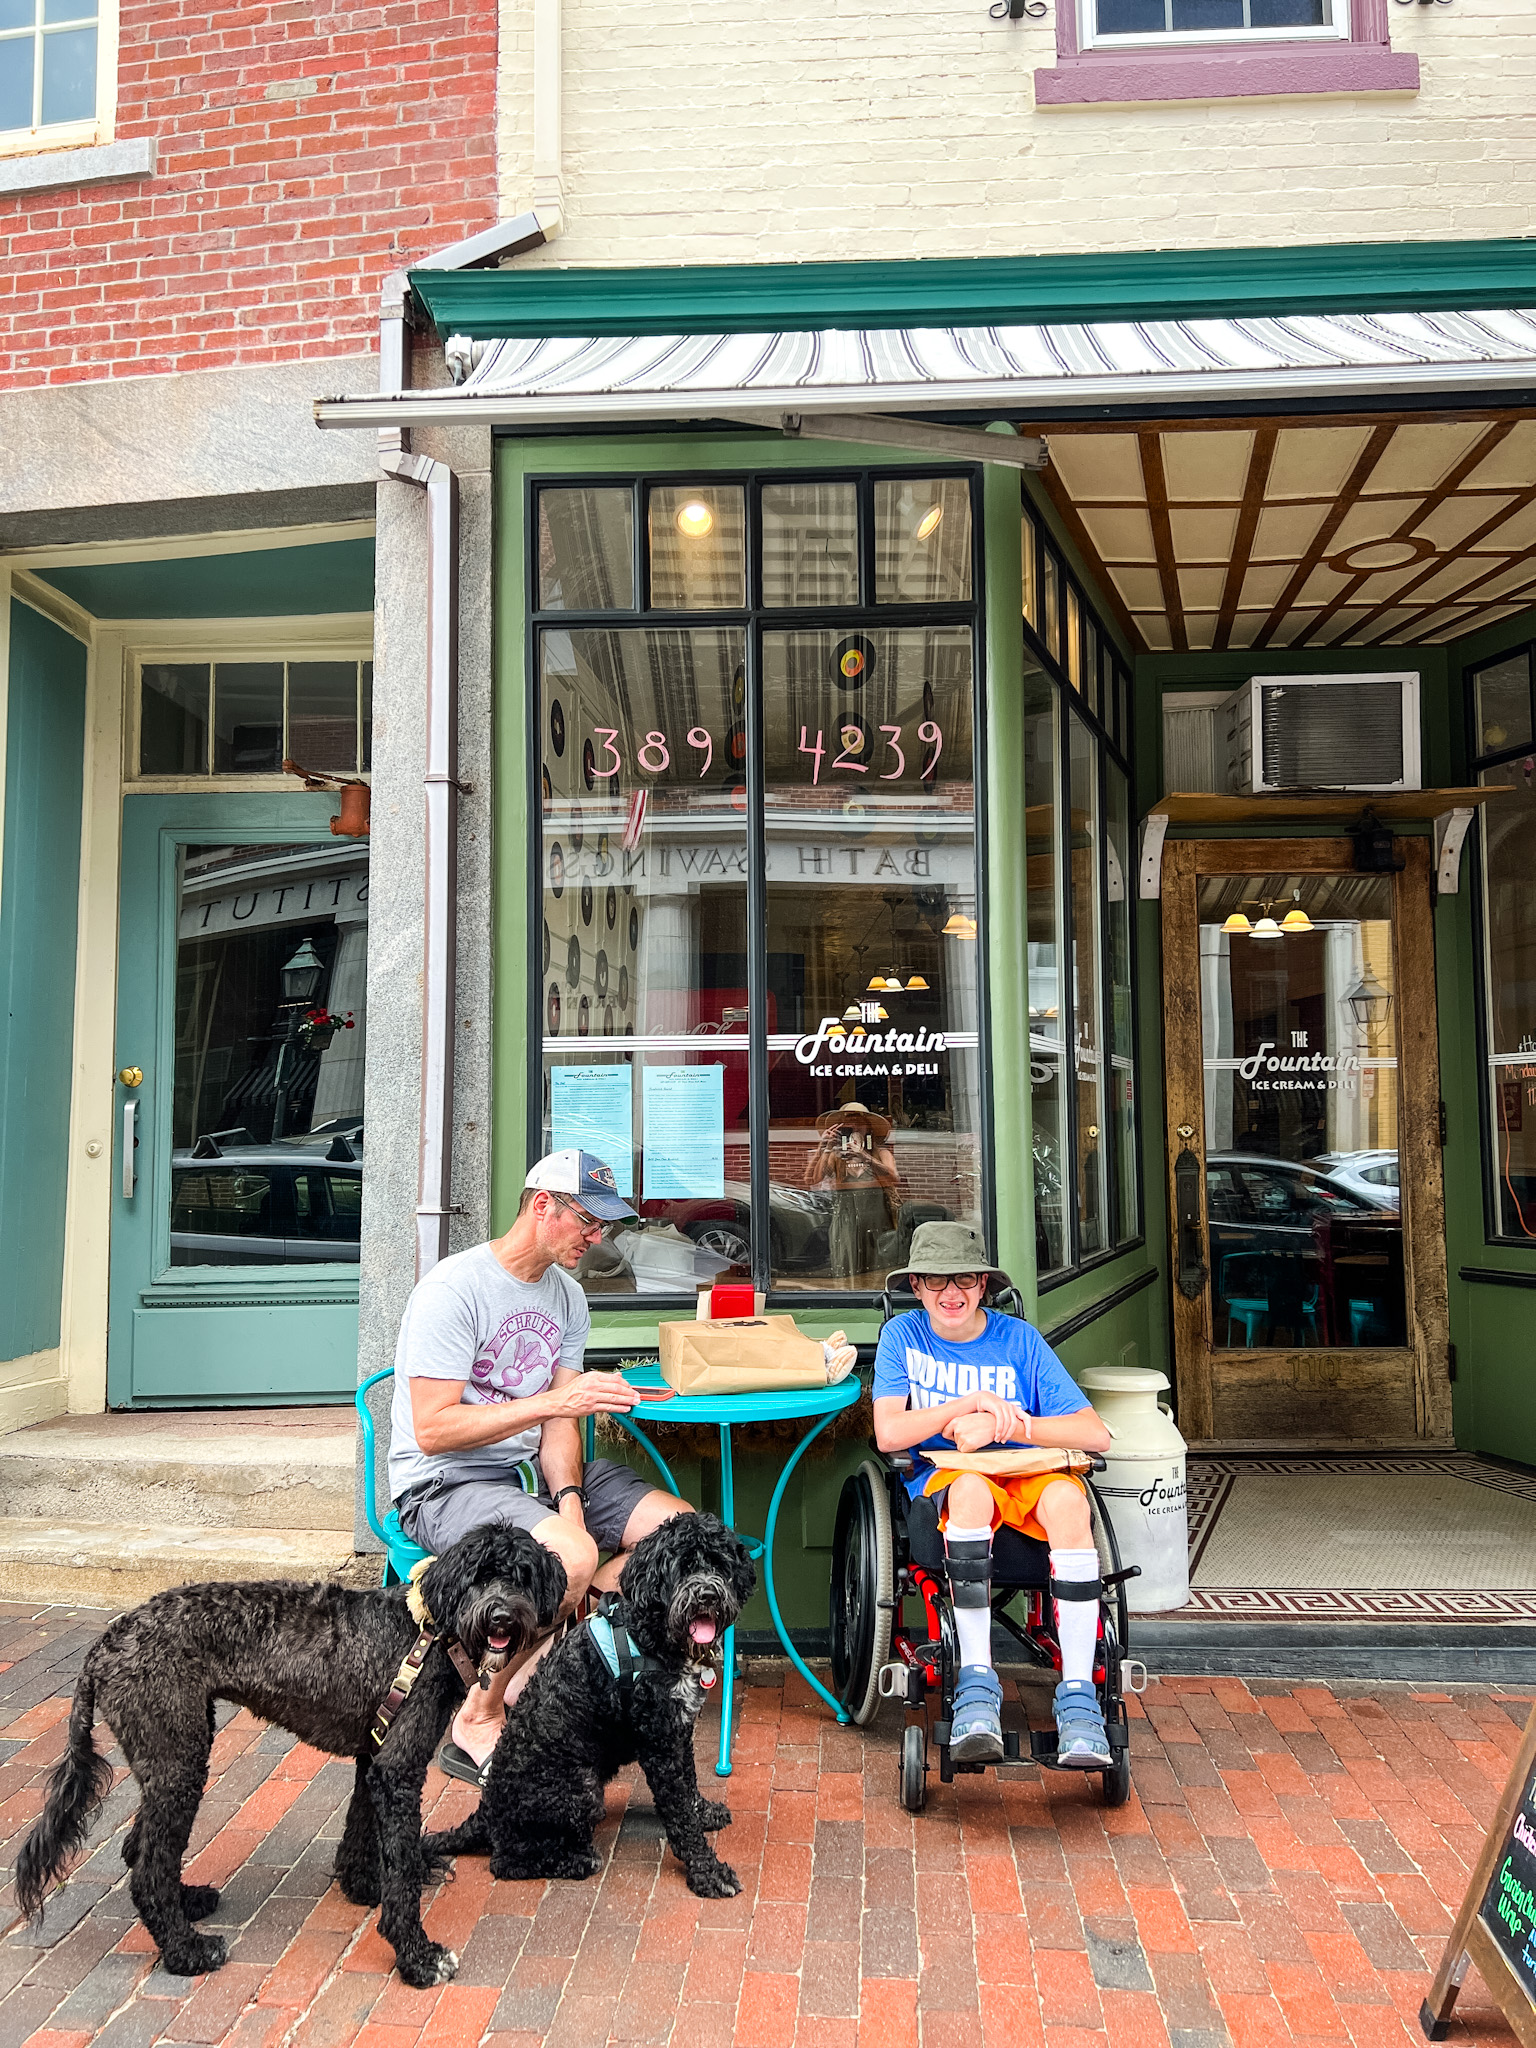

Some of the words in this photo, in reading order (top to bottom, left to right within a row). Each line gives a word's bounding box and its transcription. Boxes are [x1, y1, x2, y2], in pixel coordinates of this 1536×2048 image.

[798, 720, 943, 785] 4239
[860, 1001, 881, 1023] THE
[795, 1017, 947, 1064] Fountain
[1290, 1030, 1309, 1048] THE
[810, 1065, 832, 1077] ICE
[835, 1064, 889, 1077] CREAM
[891, 1063, 903, 1075] &
[905, 1063, 939, 1075] DELI
[1239, 1043, 1361, 1080] Fountain
[1251, 1080, 1270, 1090] ICE
[1272, 1080, 1315, 1090] CREAM
[1317, 1080, 1326, 1090] &
[1328, 1080, 1355, 1090] DELI
[499, 1314, 558, 1343] SCHRUTE
